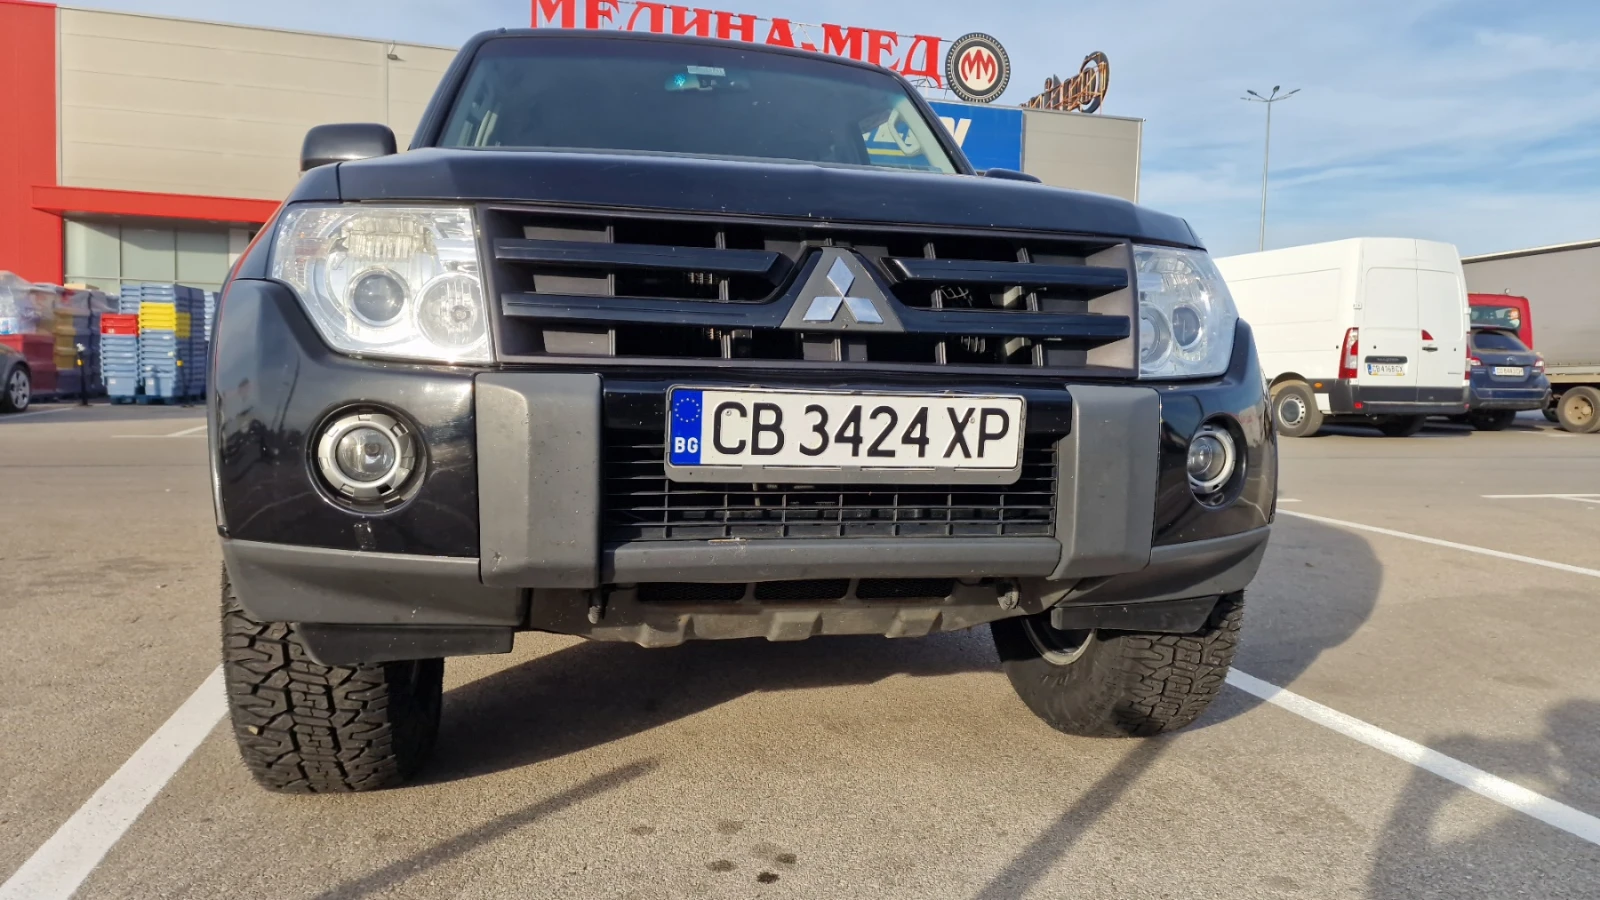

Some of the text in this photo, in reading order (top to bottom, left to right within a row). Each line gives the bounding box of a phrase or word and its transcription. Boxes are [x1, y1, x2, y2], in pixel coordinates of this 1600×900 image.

[674, 436, 699, 454] BG
[712, 401, 1010, 459] CB 3424 XP
